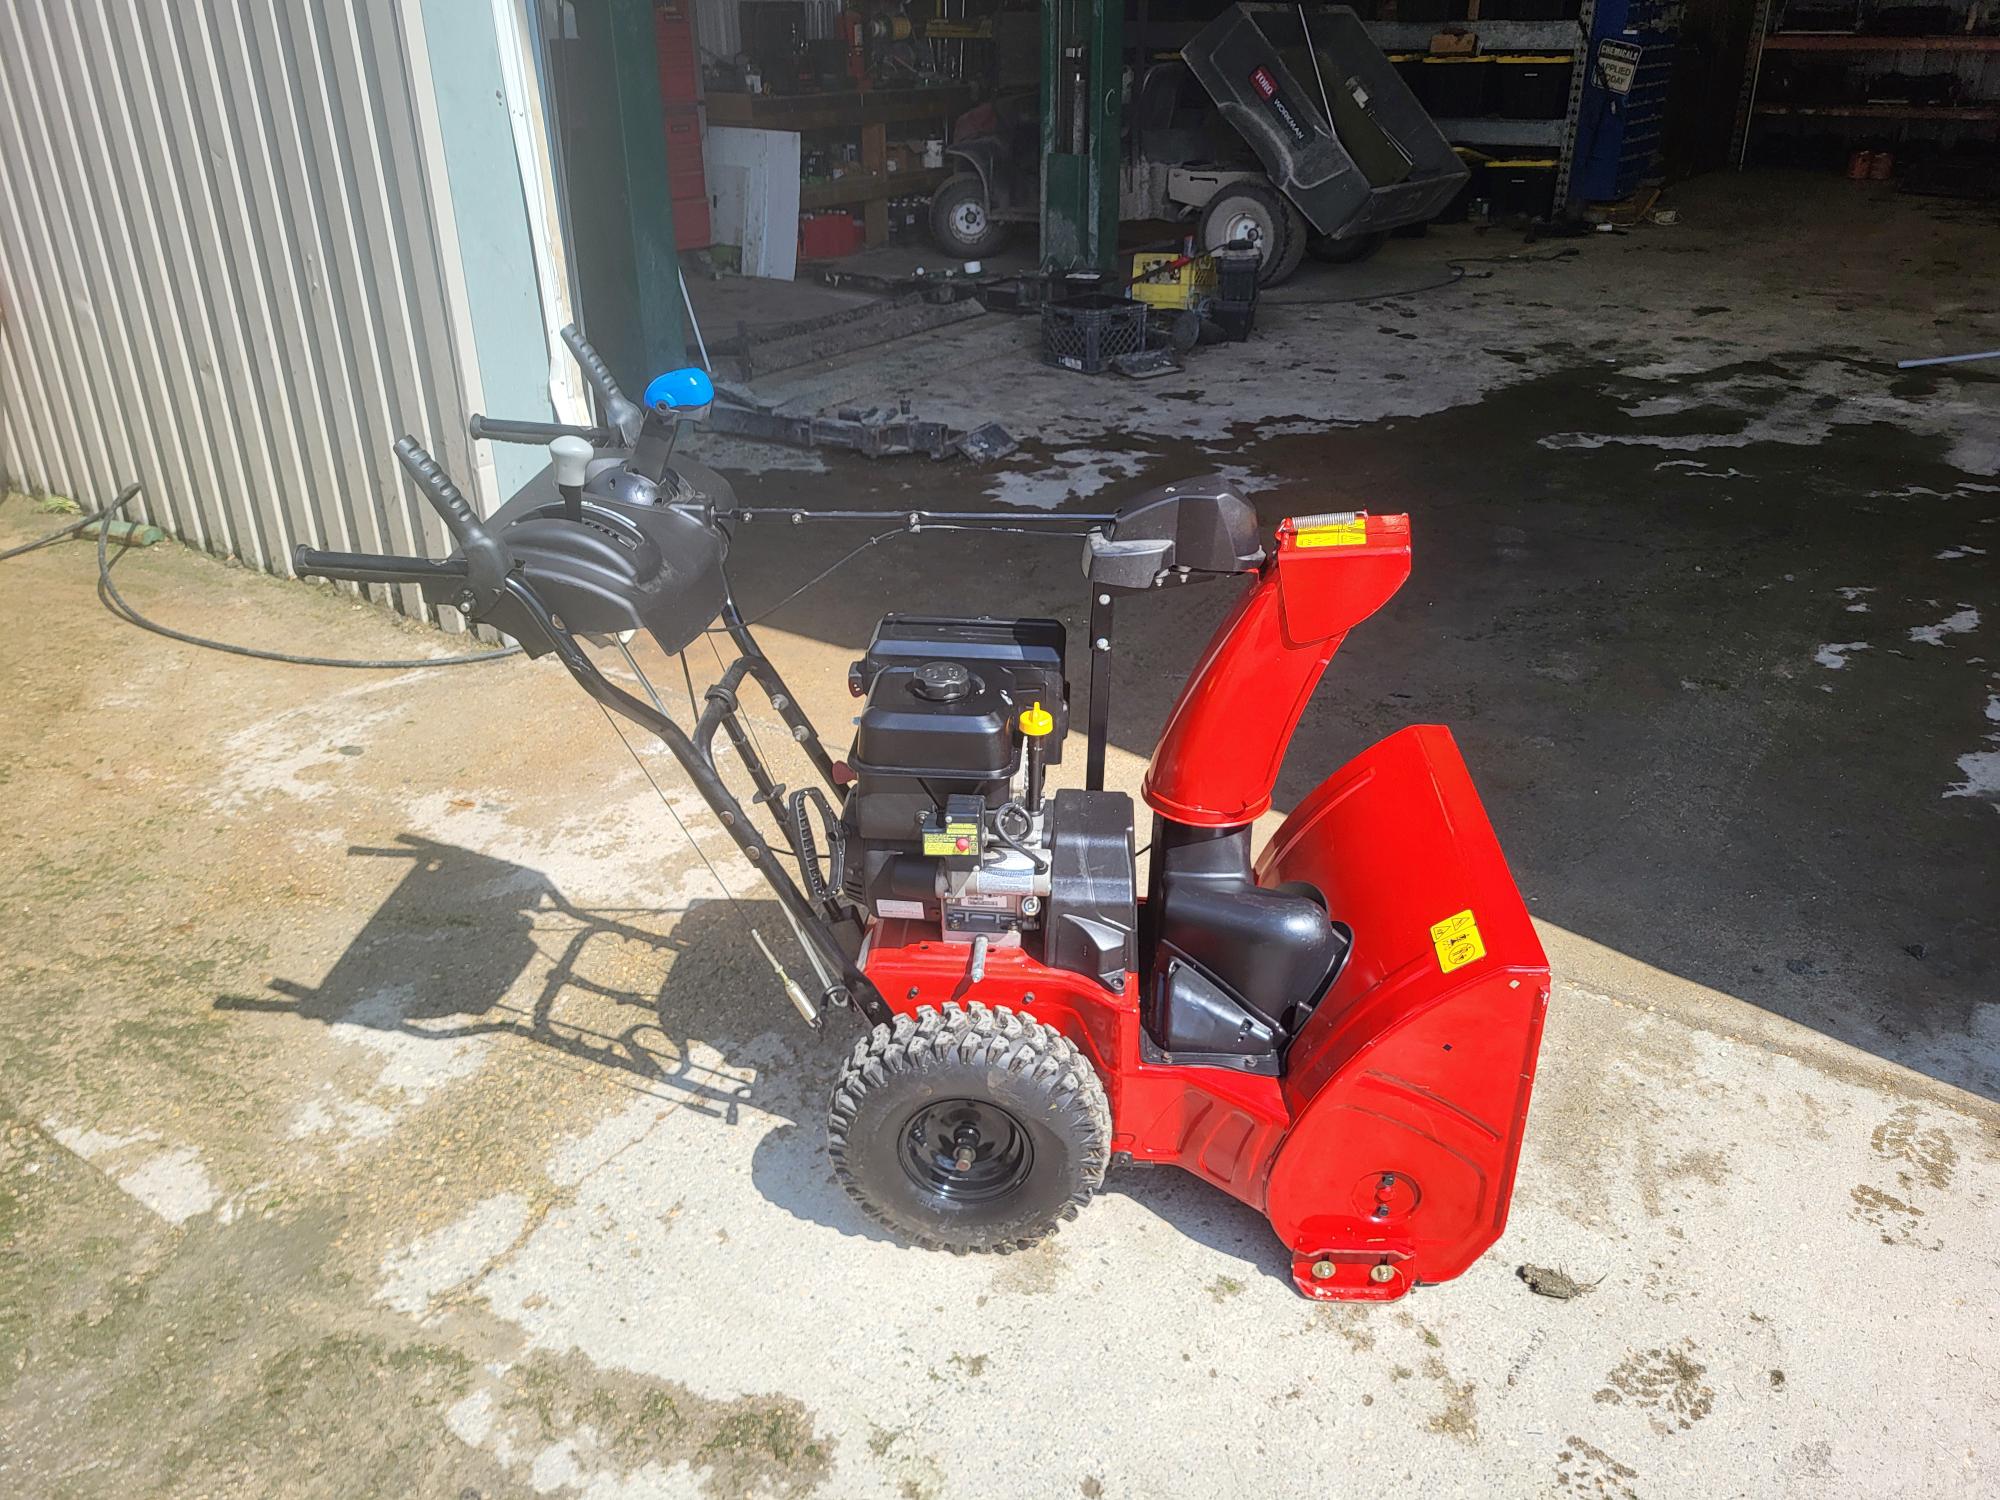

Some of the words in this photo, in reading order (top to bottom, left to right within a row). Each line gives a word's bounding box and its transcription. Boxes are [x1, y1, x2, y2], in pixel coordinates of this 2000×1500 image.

[1601, 45, 1639, 61] CHEMICALS
[1255, 70, 1274, 96] TORO
[1274, 98, 1305, 141] WORKMAN
